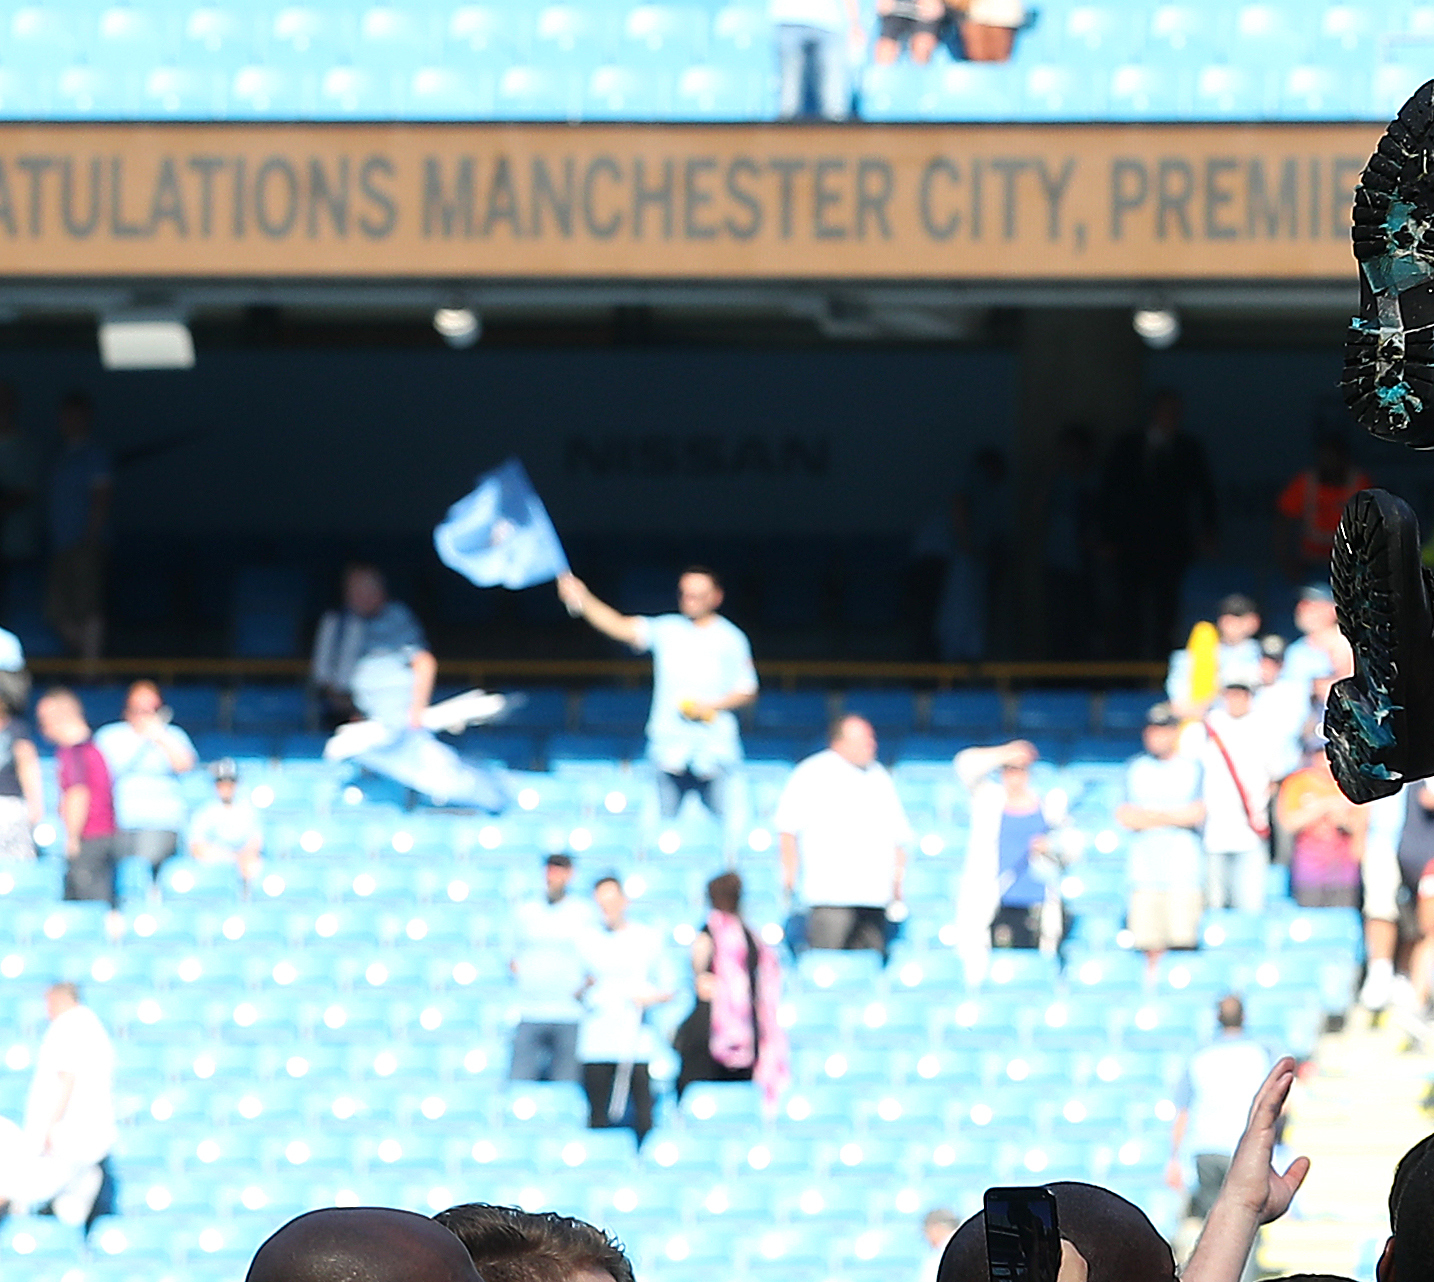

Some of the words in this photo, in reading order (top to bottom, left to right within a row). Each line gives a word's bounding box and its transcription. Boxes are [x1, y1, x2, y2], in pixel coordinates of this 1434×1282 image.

[420, 155, 894, 241] MANCHESTER
[918, 154, 1088, 254] CITY,
[1108, 155, 1360, 241] PREMIE
